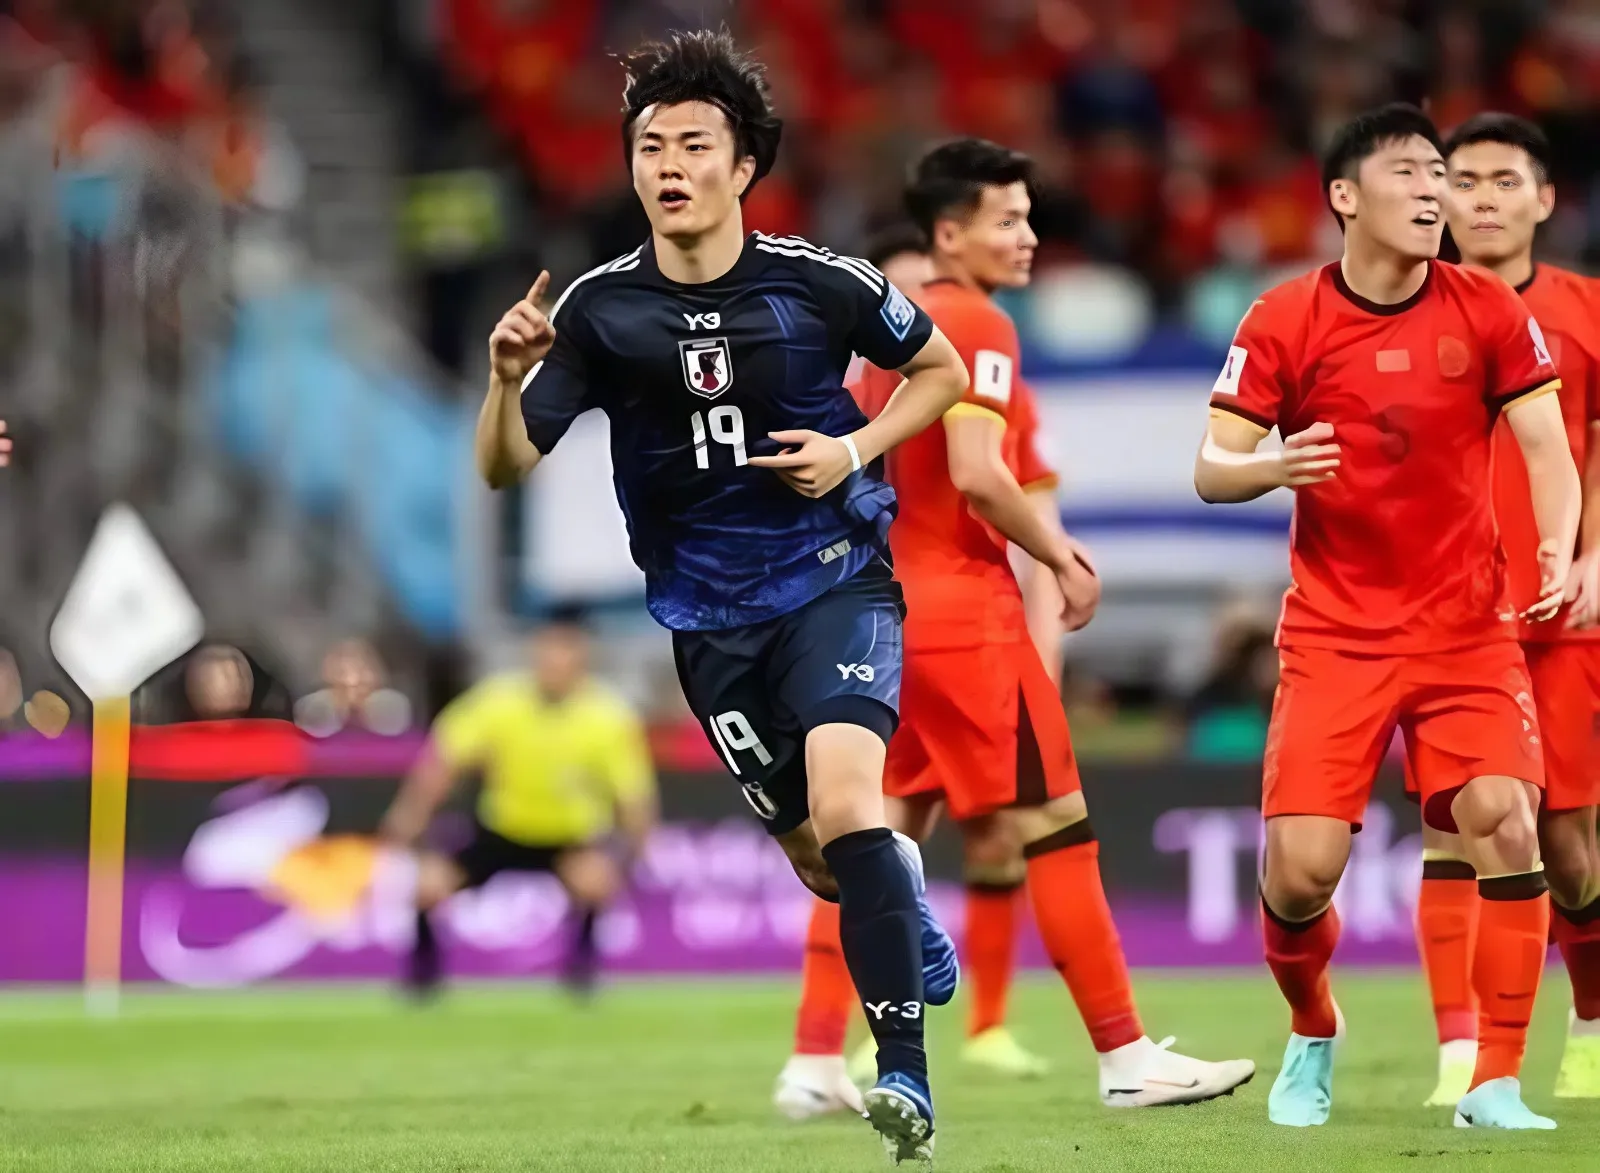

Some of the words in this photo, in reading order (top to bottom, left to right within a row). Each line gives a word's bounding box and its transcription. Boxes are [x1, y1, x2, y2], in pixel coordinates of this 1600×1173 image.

[691, 405, 748, 469] 19
[709, 710, 773, 775] 19
[865, 1000, 921, 1020] Y-3
